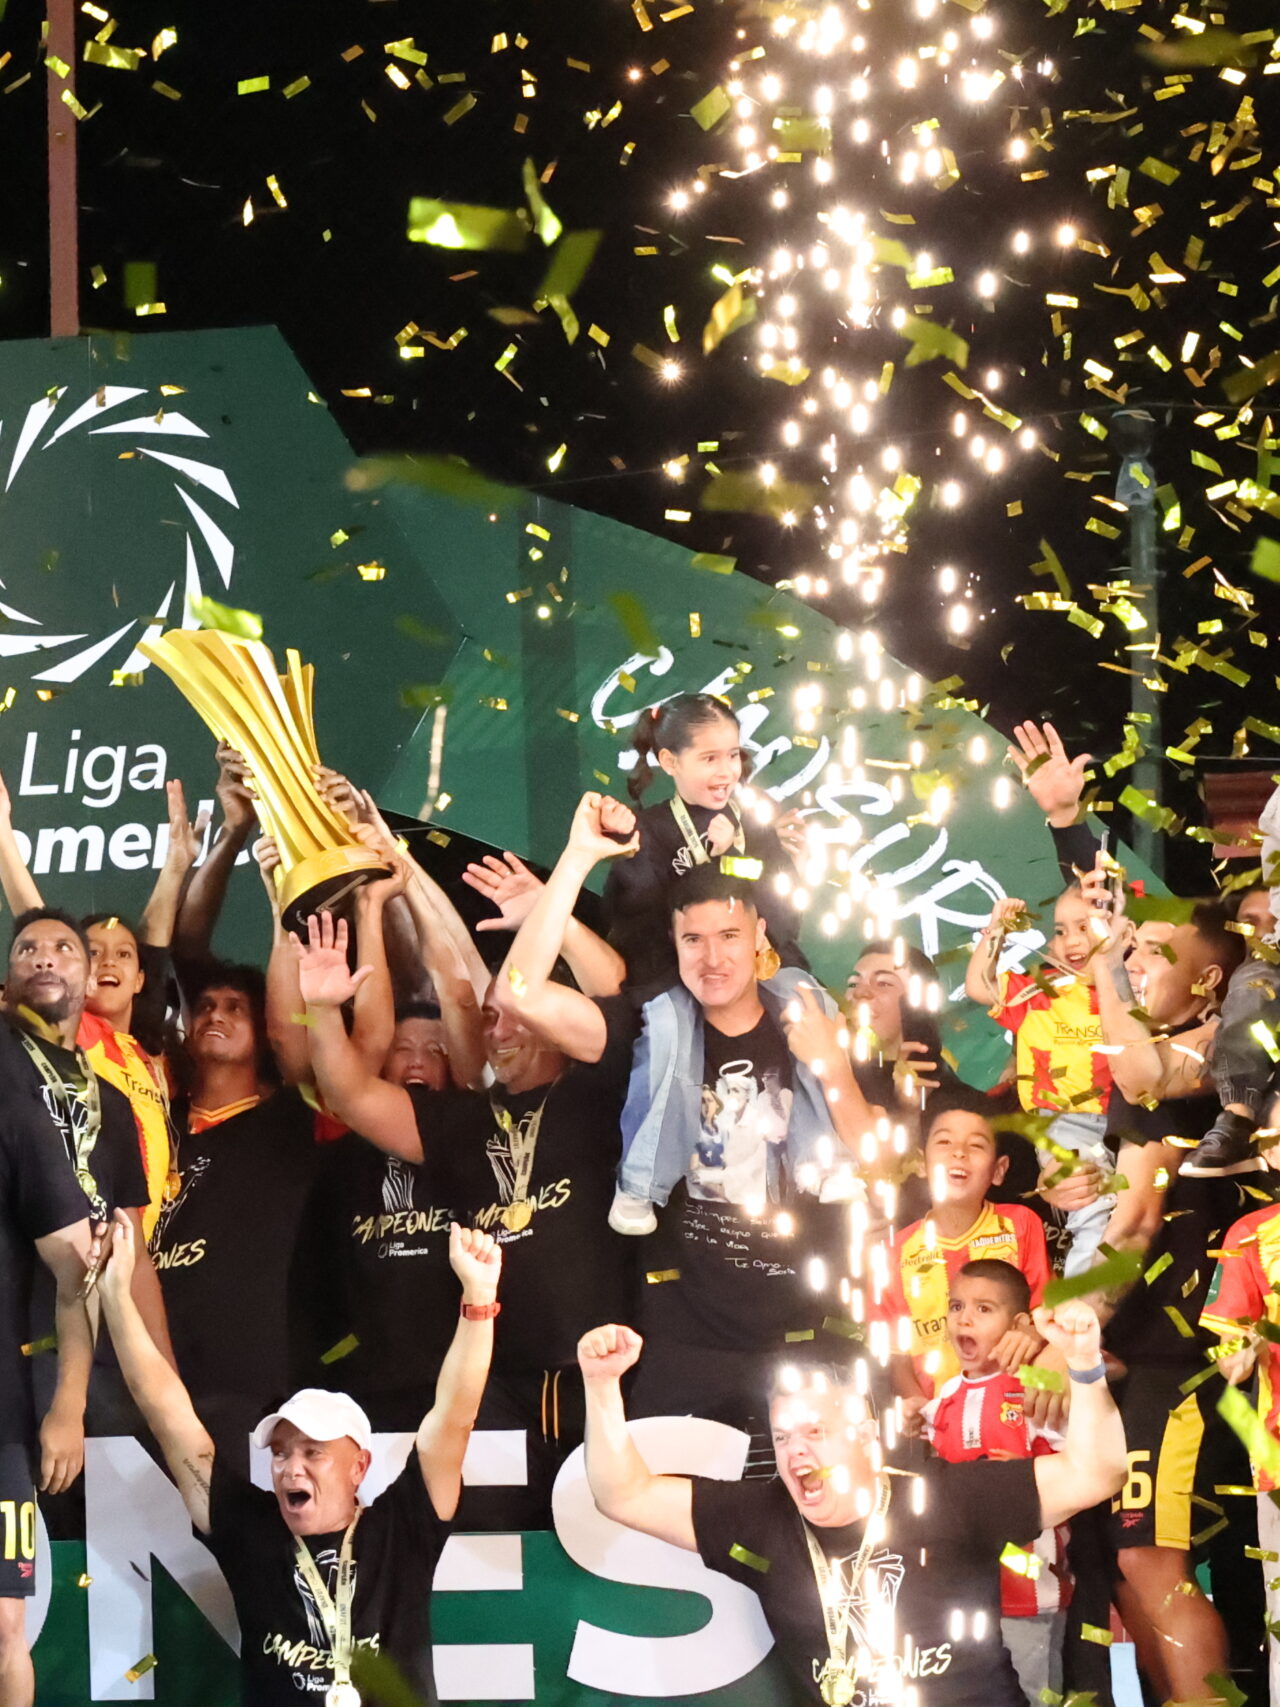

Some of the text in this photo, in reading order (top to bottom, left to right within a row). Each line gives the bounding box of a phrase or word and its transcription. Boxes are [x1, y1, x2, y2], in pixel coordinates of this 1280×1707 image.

[19, 729, 167, 808] Liga
[389, 1241, 404, 1250] Liga
[389, 1247, 428, 1257] Promerica
[1111, 1450, 1153, 1514] 6
[0, 1501, 35, 1560] 10
[307, 1674, 325, 1684] Liga
